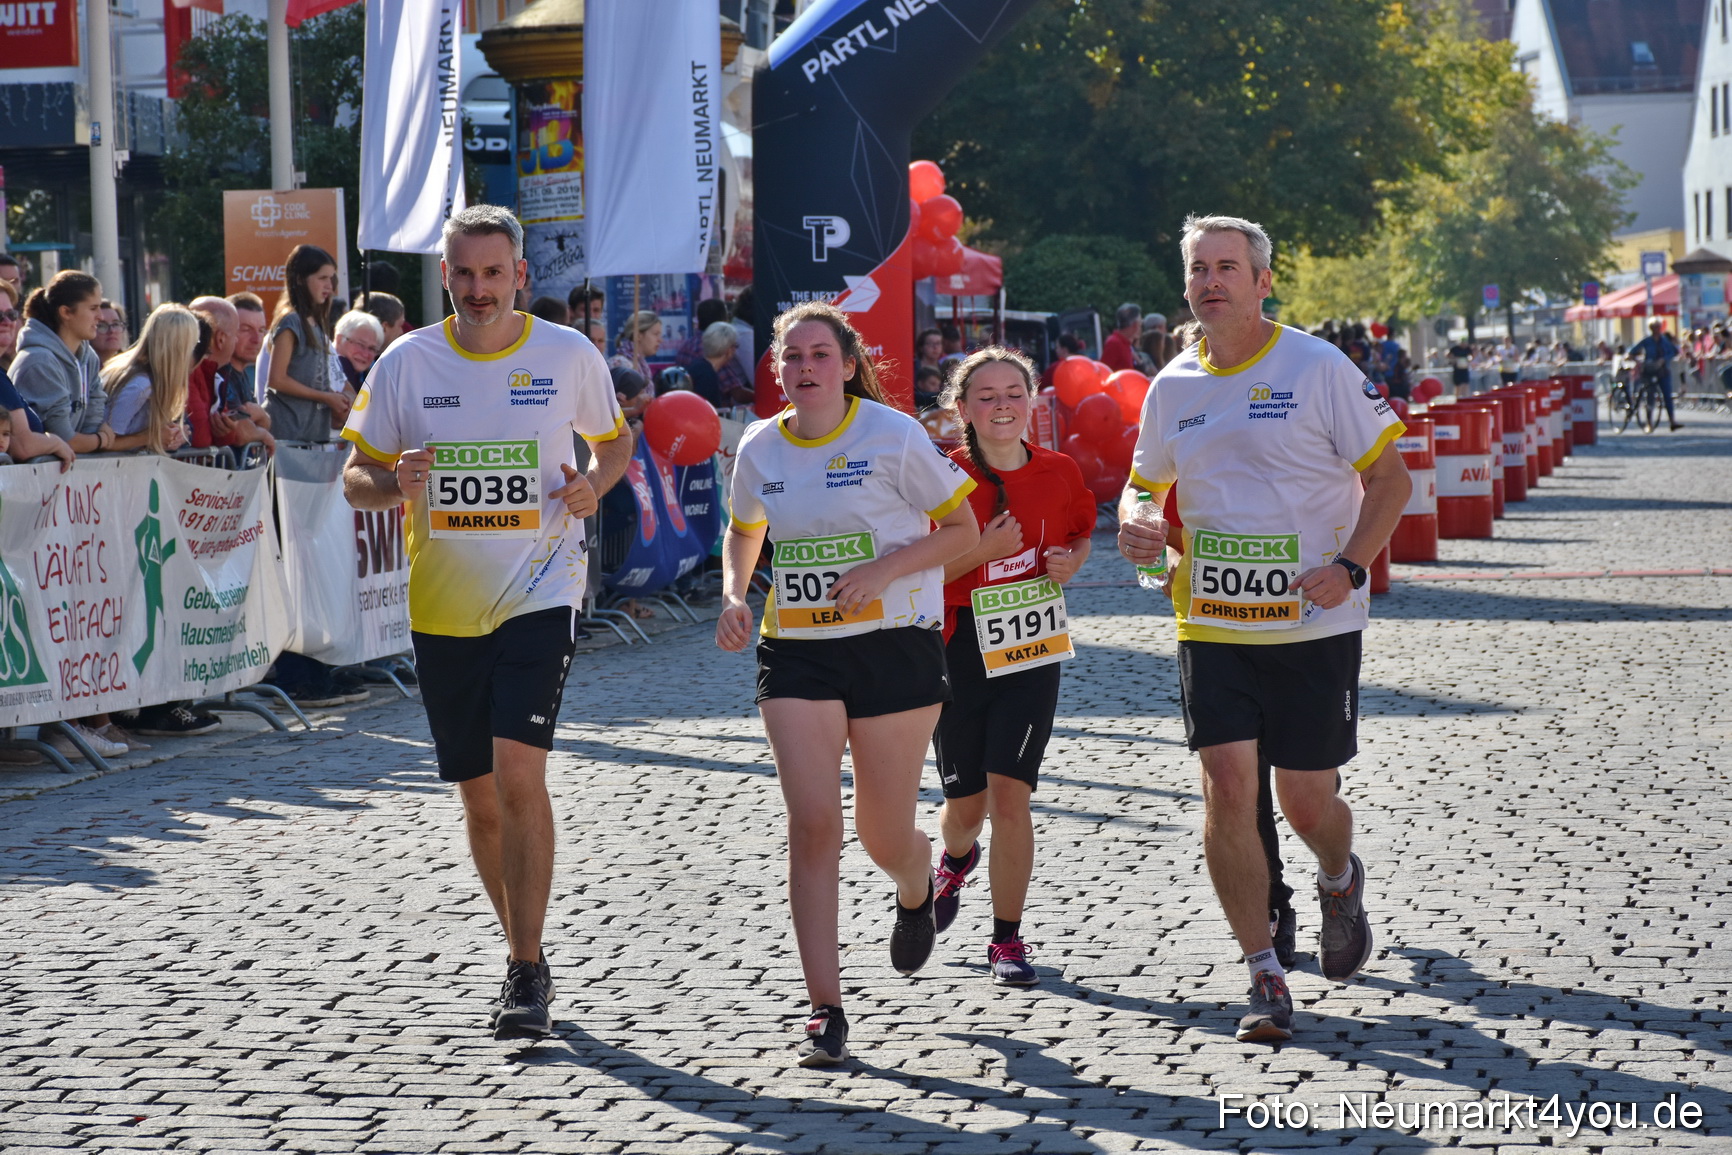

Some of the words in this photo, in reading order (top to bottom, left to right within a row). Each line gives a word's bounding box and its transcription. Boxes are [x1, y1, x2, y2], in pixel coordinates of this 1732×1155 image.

[801, 19, 889, 84] PARTL
[692, 60, 714, 182] NEUMARKT
[557, 185, 580, 195] 2019
[284, 203, 306, 211] CODE
[284, 211, 311, 219] CLINIC
[791, 291, 808, 301] THE
[510, 373, 531, 387] 20
[510, 388, 558, 396] Neumarkter
[1250, 388, 1271, 401] 20
[423, 396, 461, 405] BOCK
[510, 398, 549, 407] Stadtlauf
[1249, 402, 1298, 410] Neumarkter
[1248, 411, 1288, 420] Stadtlauf
[434, 444, 532, 468] BOCK
[827, 456, 846, 470] 20
[827, 470, 873, 479] Neumarkter
[440, 475, 528, 505] 5038
[689, 477, 714, 492] ONLINE
[826, 478, 863, 488] Stadtlauf
[66, 482, 102, 525] UNS
[448, 515, 520, 527] MARKUS
[778, 535, 868, 564] BOCK
[1200, 536, 1293, 560] BOCK
[1003, 559, 1027, 573] DEHN
[785, 571, 840, 602] 503
[1202, 565, 1288, 597] 5040
[979, 579, 1058, 612] BOCK
[812, 612, 844, 624] LEA
[1201, 603, 1290, 619] CHRISTIAN
[987, 605, 1056, 645] 5191
[1005, 643, 1050, 662] KATJA
